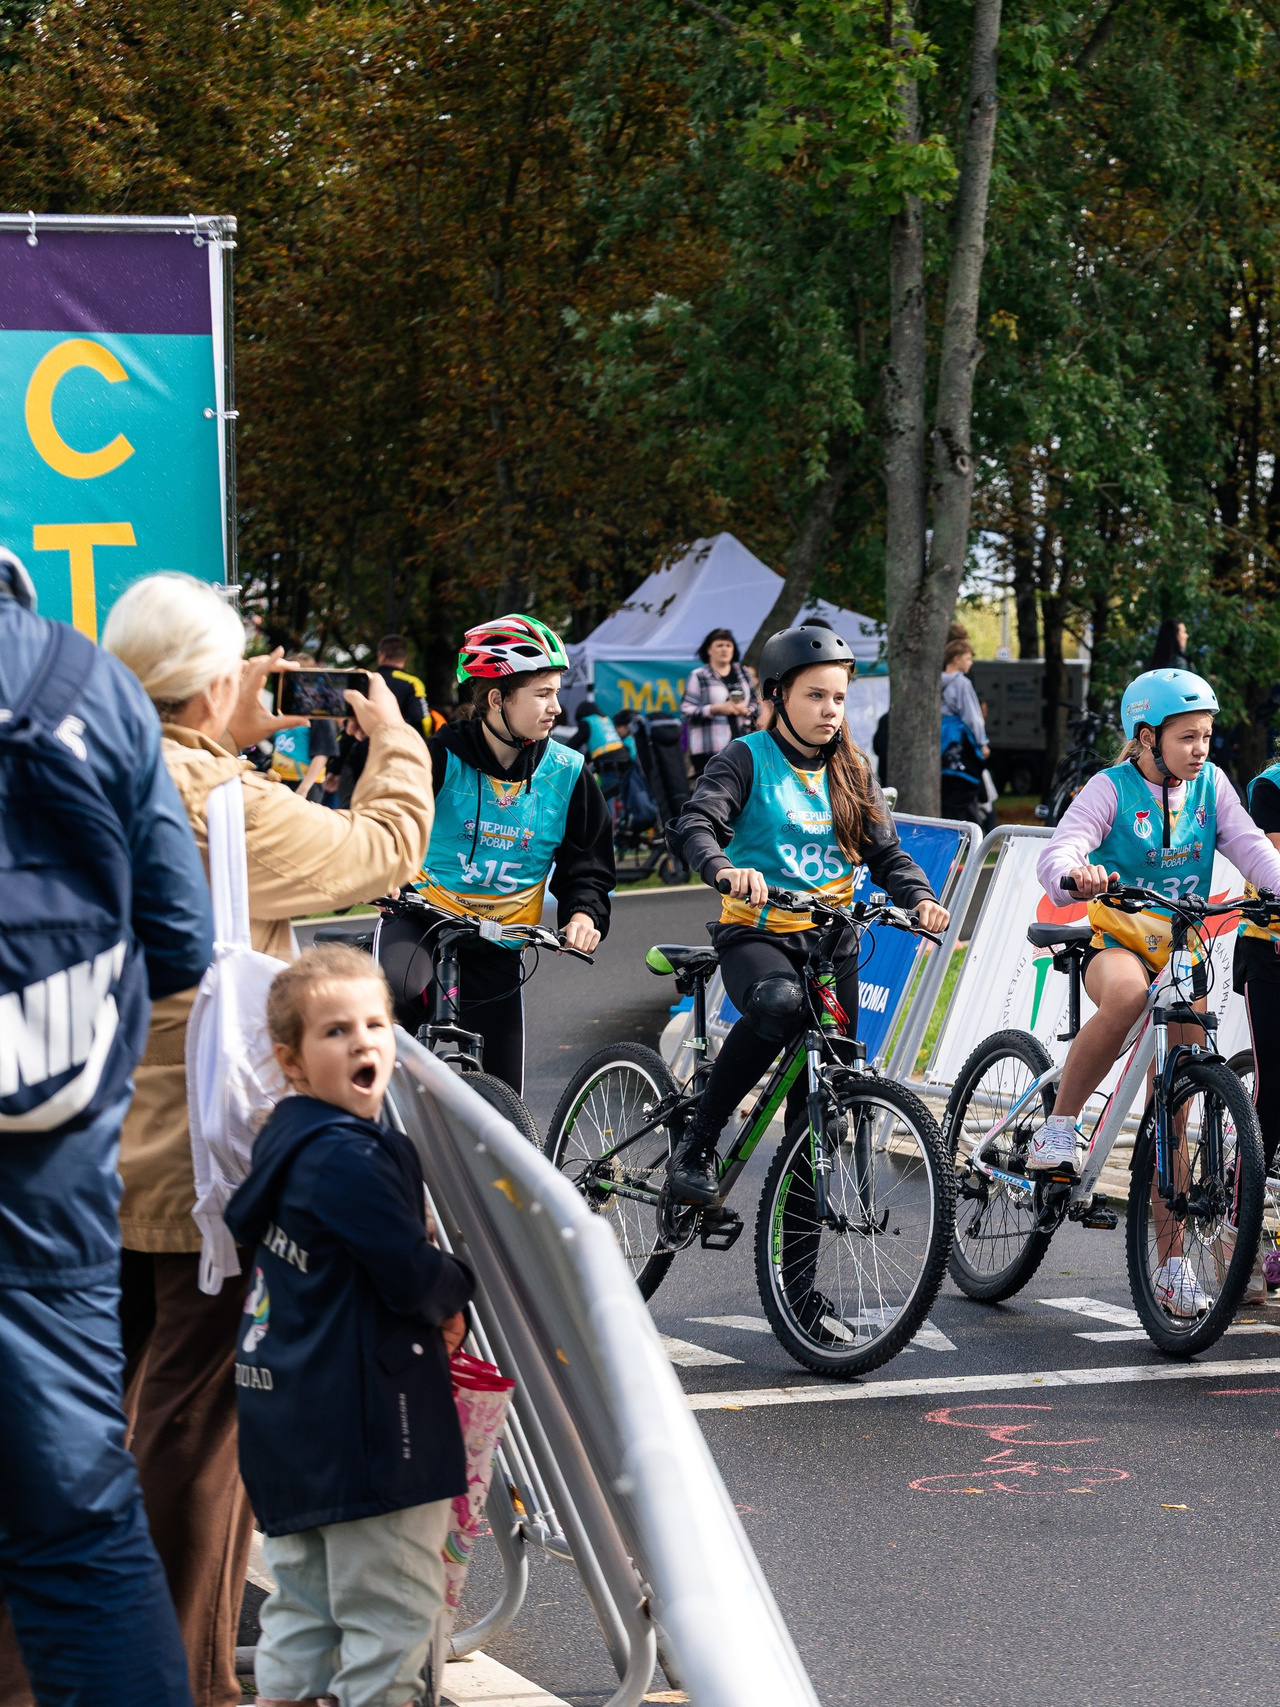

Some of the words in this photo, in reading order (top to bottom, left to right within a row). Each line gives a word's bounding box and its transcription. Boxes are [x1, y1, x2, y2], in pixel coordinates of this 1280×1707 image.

[480, 821, 521, 837] ПЕРШЫ
[803, 824, 832, 835] РОВАР
[480, 835, 514, 850] РОВАР
[1161, 843, 1191, 857] ПЕРШЫ
[779, 842, 844, 881] 385
[1161, 856, 1187, 868] РОВАР
[457, 852, 522, 894] 415
[0, 937, 128, 1100] NIK
[616, 1186, 652, 1203] STELS
